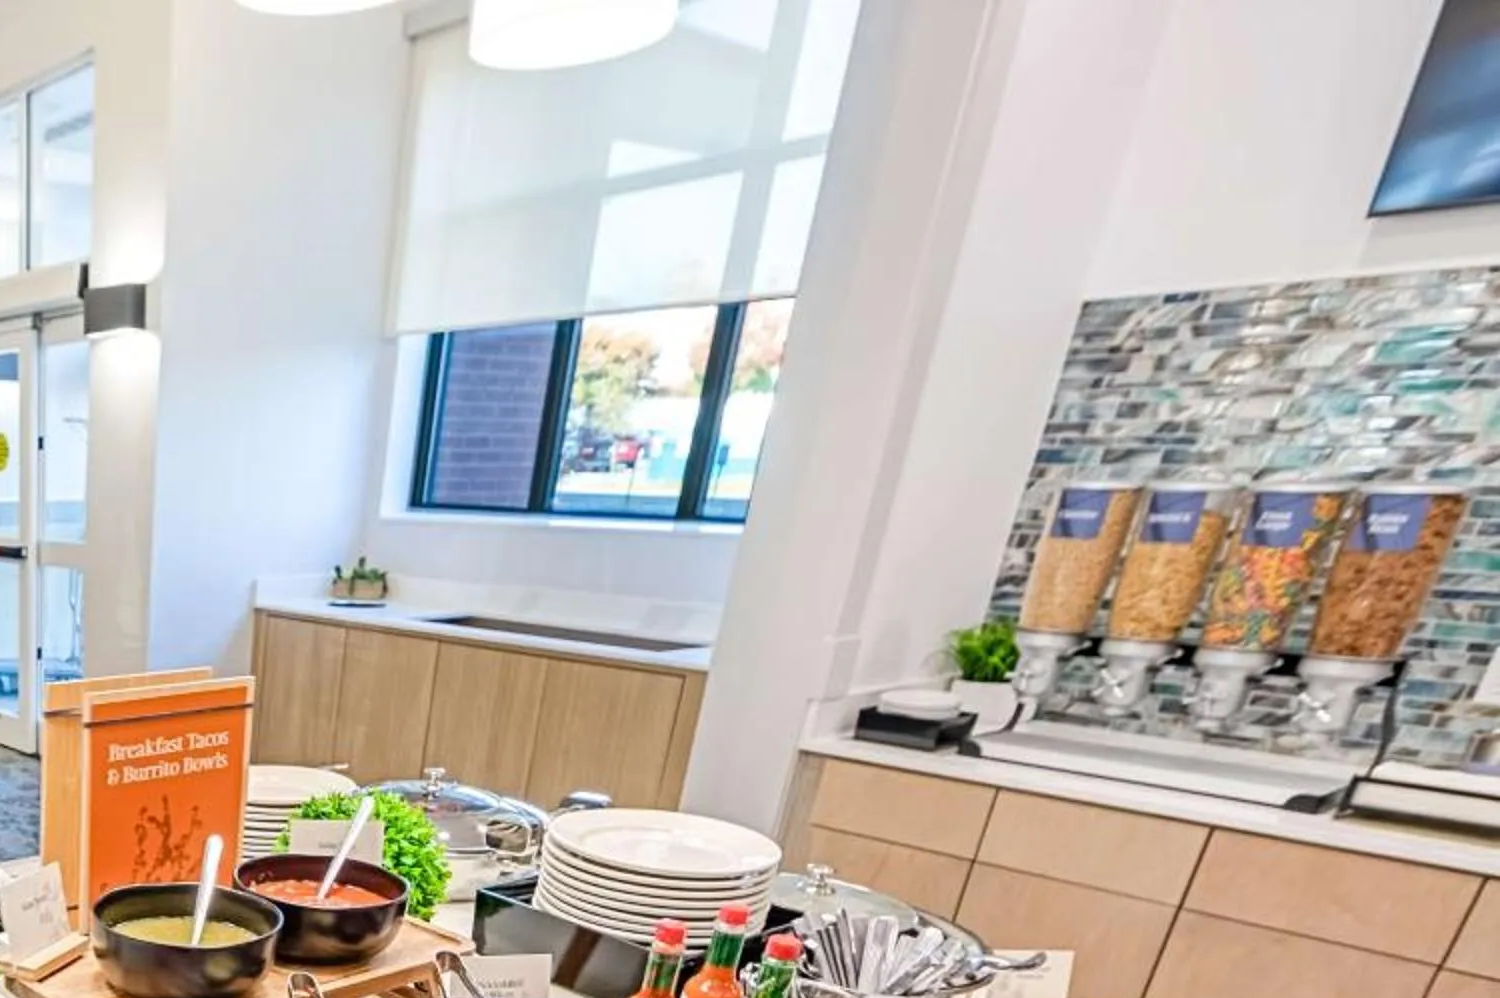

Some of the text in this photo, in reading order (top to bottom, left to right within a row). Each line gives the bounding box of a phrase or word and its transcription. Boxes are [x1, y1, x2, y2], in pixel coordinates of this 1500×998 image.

[108, 731, 229, 763] Breakfast Tacos
[106, 751, 229, 786] & Burrito Bowls
